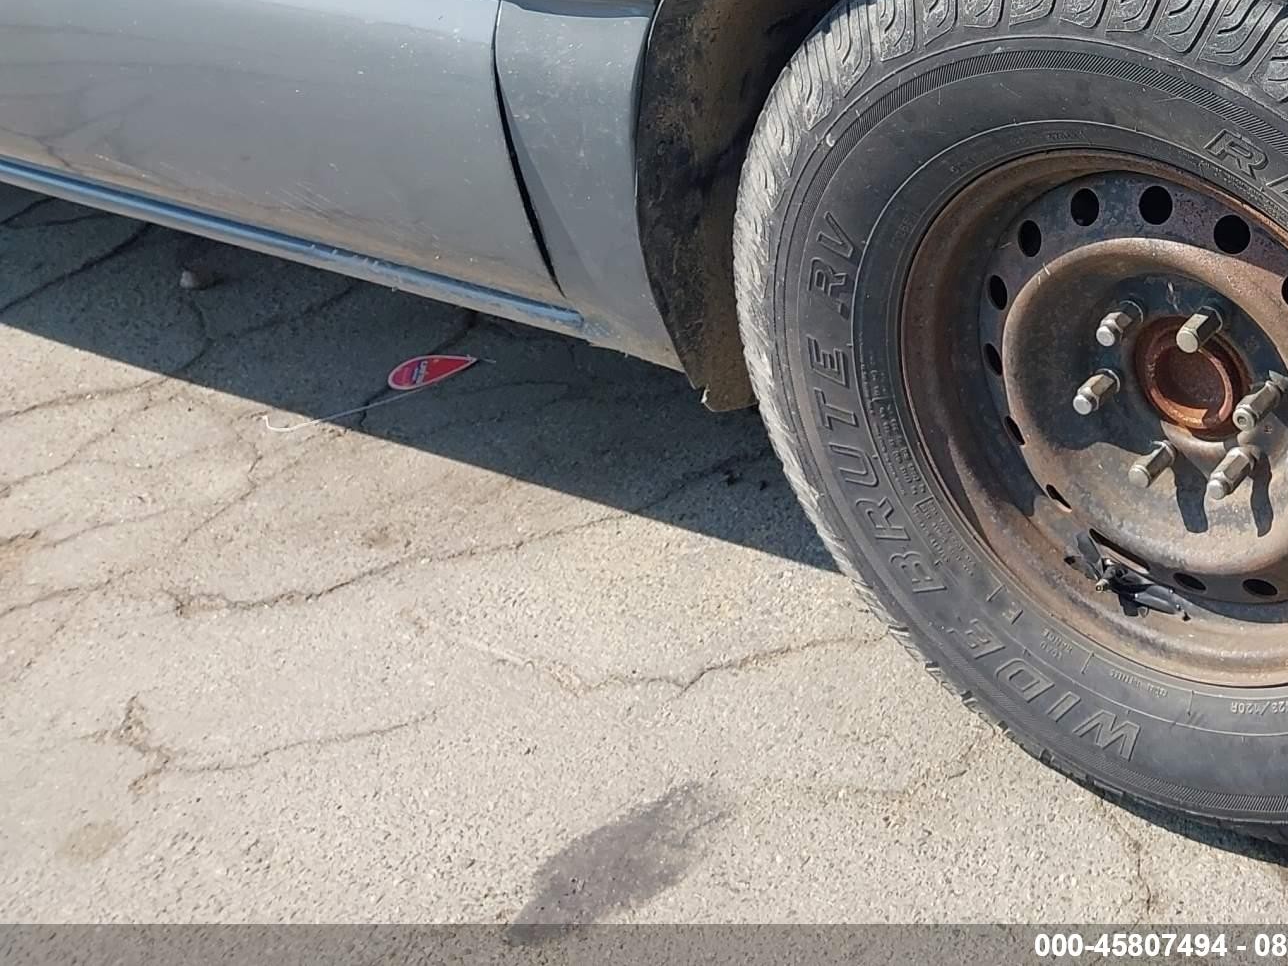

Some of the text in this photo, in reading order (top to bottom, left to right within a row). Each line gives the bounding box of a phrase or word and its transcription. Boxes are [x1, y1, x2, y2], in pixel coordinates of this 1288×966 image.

[808, 210, 854, 320] RV
[807, 333, 948, 594] BRUTE
[941, 618, 1141, 762] WIDE
